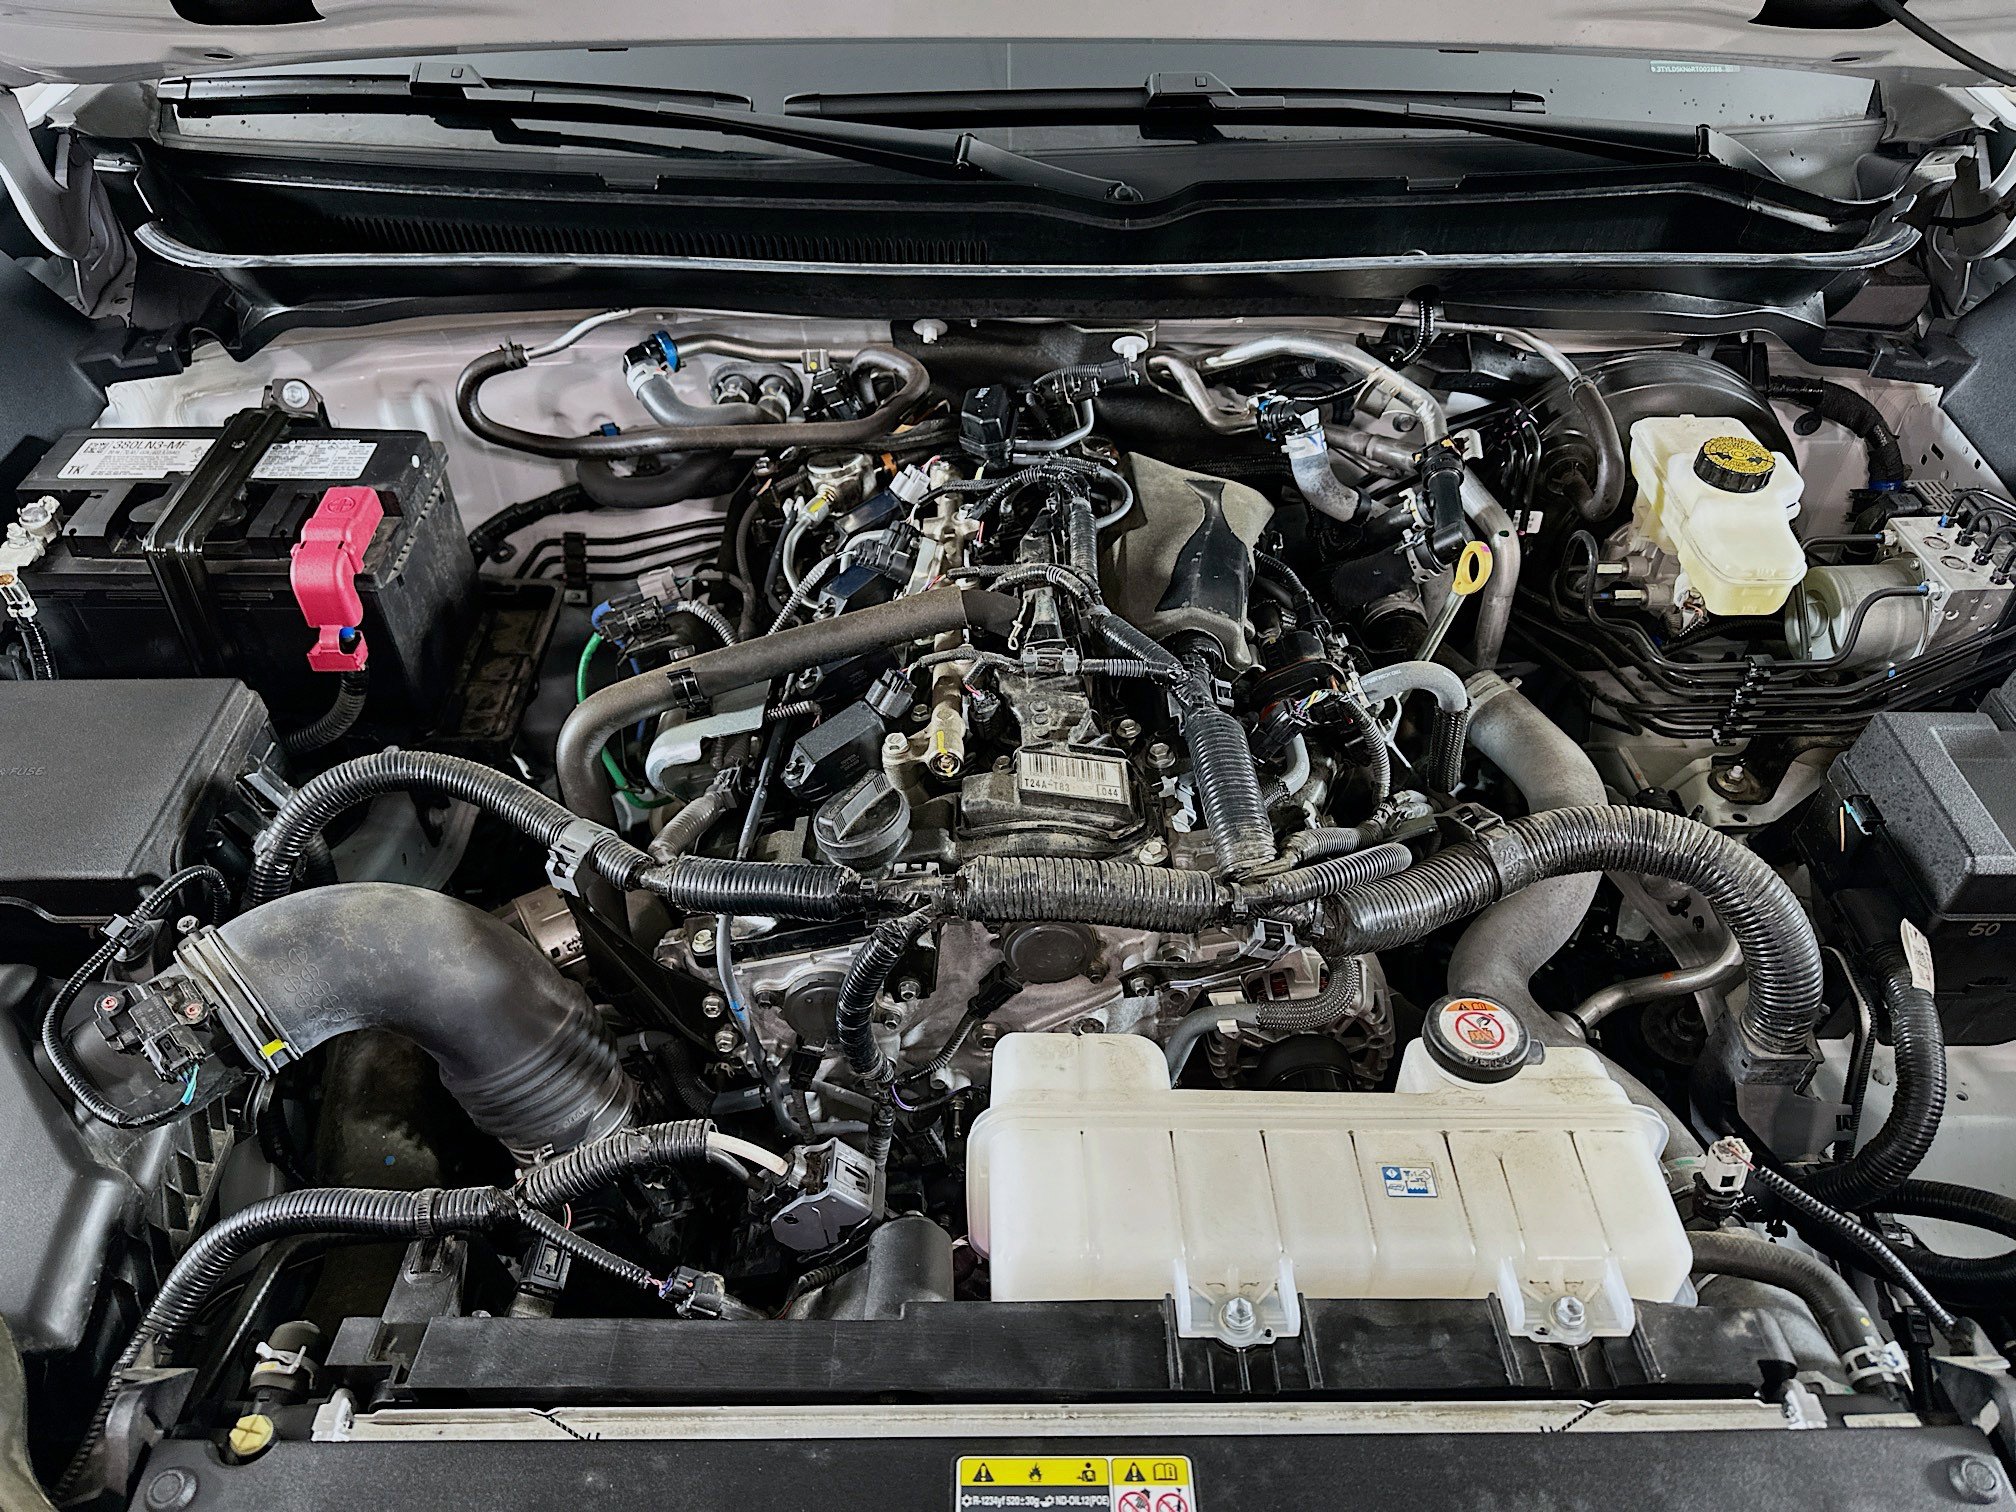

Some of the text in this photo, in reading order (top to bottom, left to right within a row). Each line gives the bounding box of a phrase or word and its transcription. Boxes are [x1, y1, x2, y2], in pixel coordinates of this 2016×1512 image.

[112, 440, 189, 450] 380LN3-MF
[9, 766, 46, 776] FUSE
[1968, 922, 2001, 937] 50
